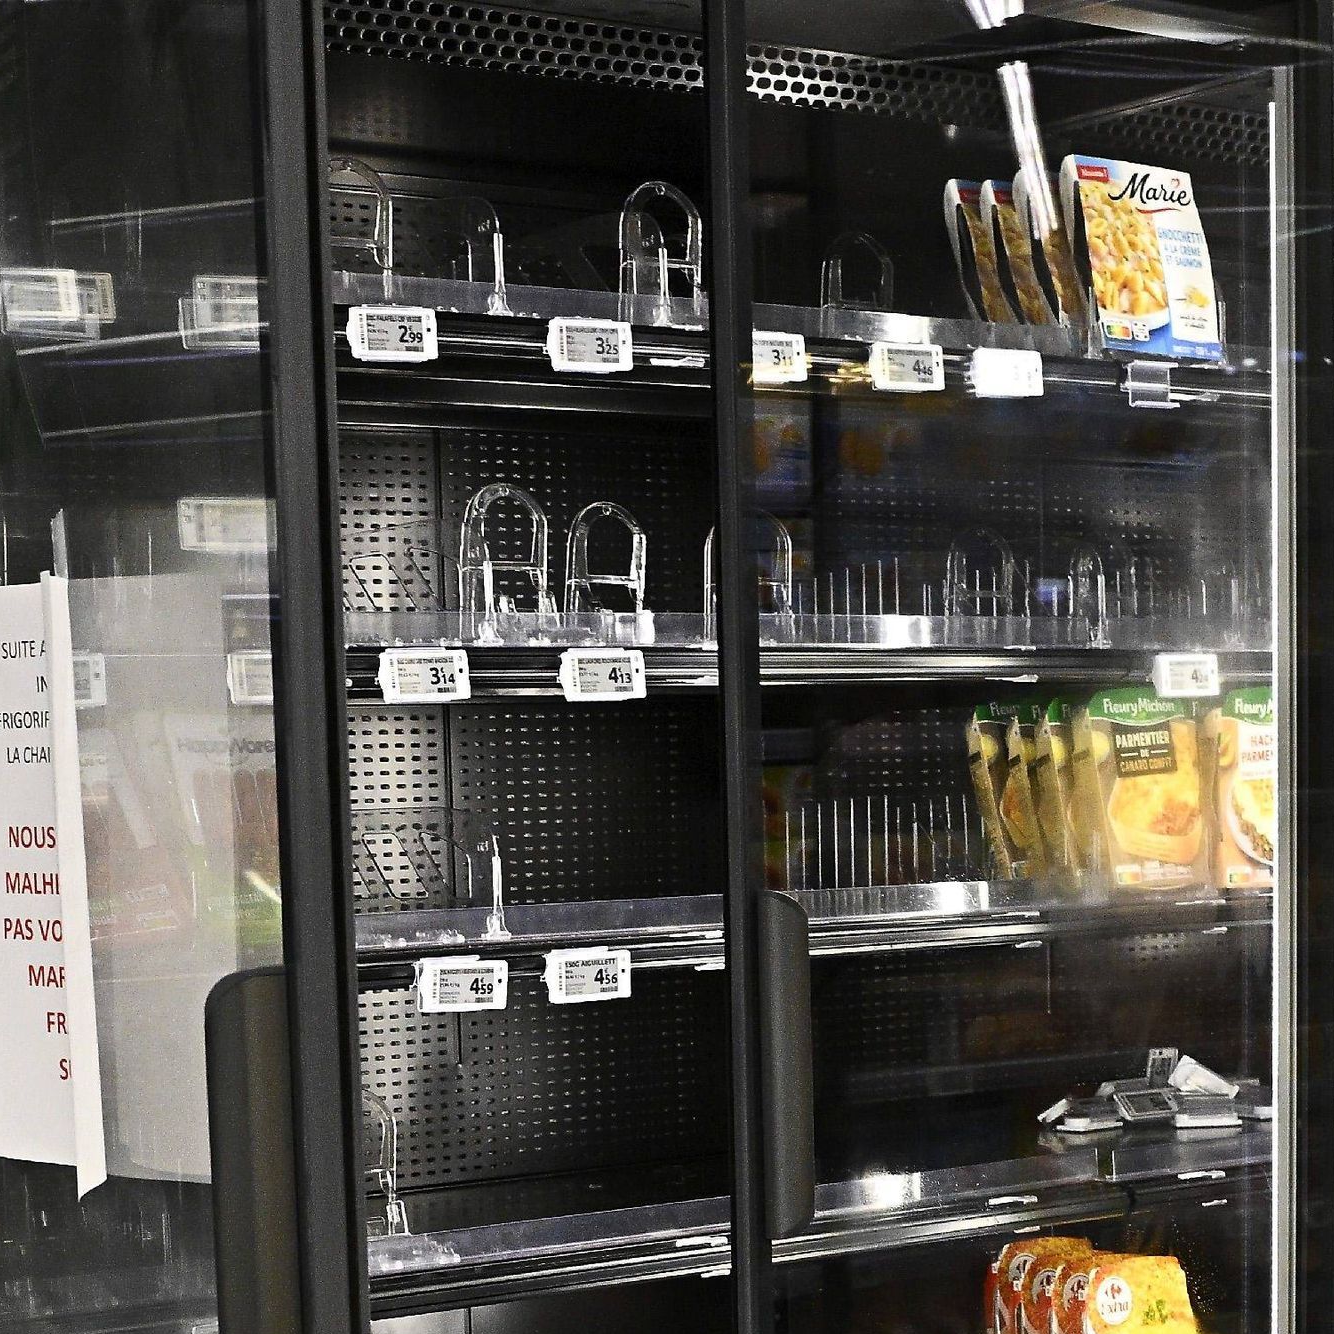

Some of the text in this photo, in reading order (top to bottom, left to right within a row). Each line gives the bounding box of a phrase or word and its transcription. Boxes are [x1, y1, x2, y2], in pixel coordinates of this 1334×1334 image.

[1108, 172, 1192, 206] Marie
[398, 325, 423, 343] 2€99
[1, 640, 36, 659] SUITE
[430, 667, 455, 684] 3€14
[608, 667, 631, 684] 4€13
[1115, 731, 1170, 749] PARMENTIER
[6, 746, 21, 763] LA
[8, 826, 56, 848] NOUS
[3, 918, 34, 941] PAS
[594, 968, 617, 984] 4€56
[469, 977, 493, 994] 4€59
[59, 1058, 72, 1080] S
